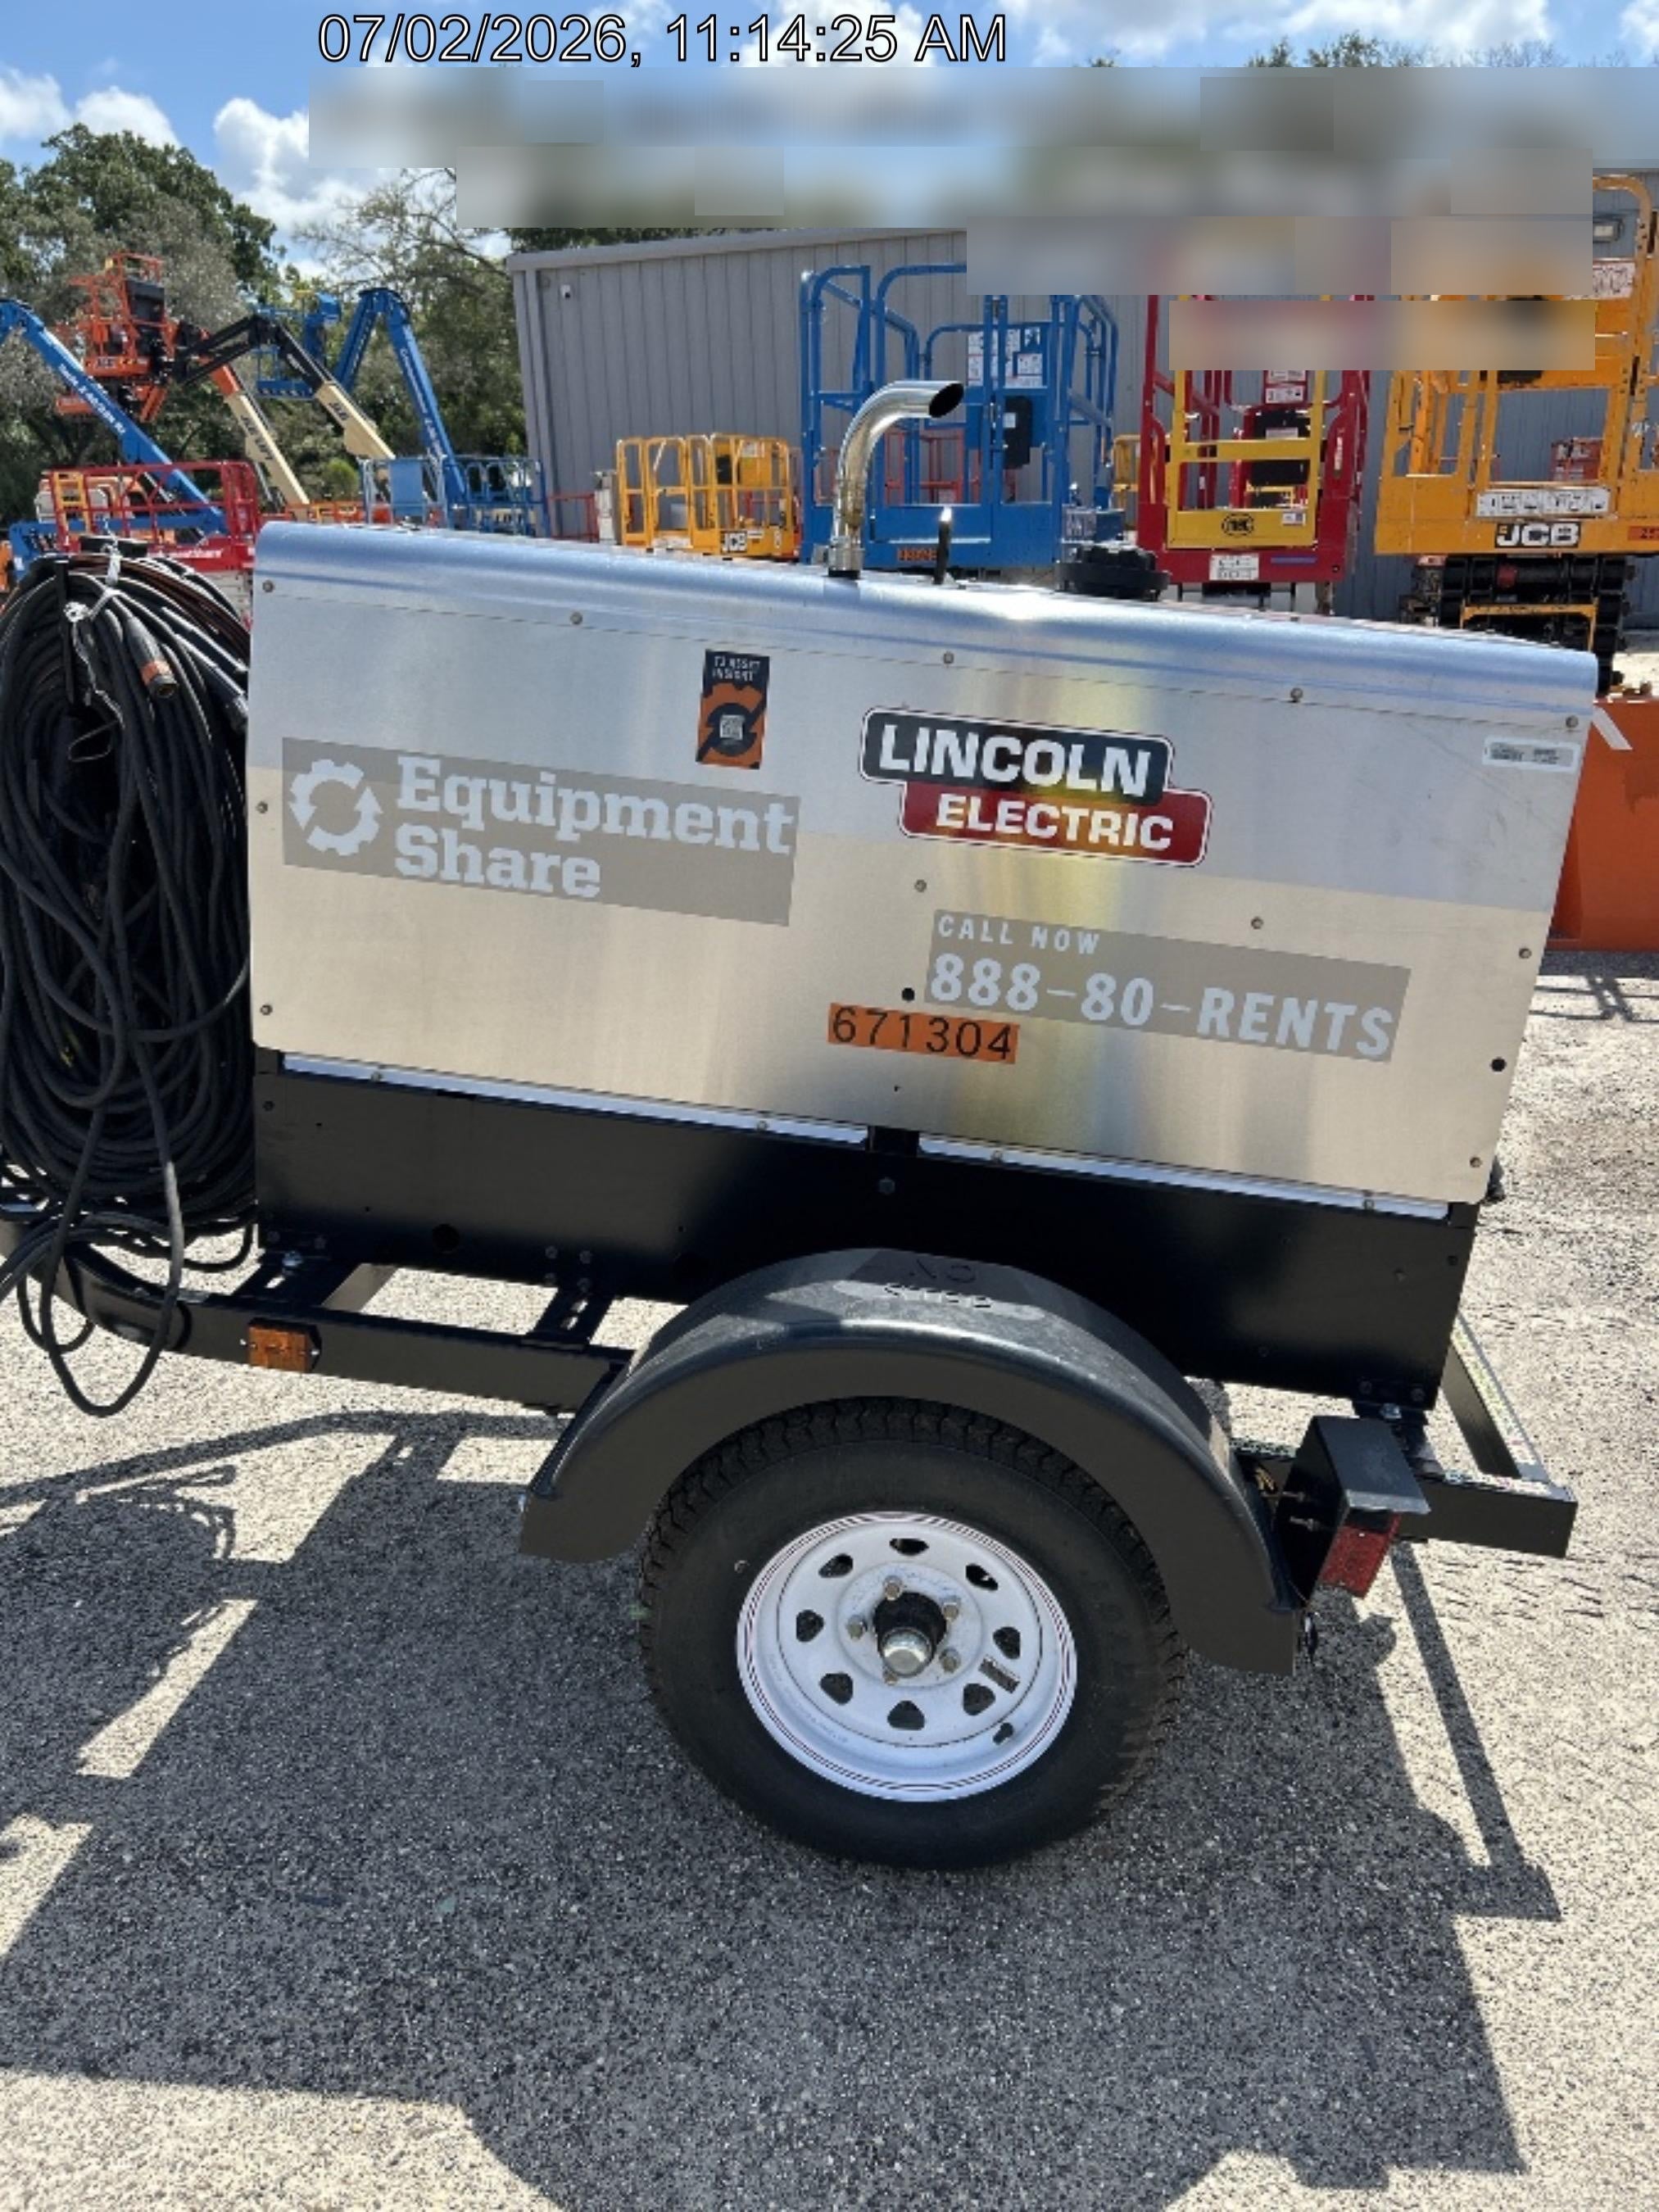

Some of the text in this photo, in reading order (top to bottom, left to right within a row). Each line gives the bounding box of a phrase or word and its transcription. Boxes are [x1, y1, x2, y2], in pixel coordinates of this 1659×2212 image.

[721, 532, 747, 552] JCB
[1496, 523, 1580, 548] JCB
[879, 723, 1152, 797] LINCOLN
[397, 755, 794, 855] Equipment
[936, 792, 1175, 851] ELECTRIC
[395, 823, 601, 899] Share
[937, 913, 1100, 956] CALL NOW
[831, 1005, 1015, 1060] 671304
[930, 951, 1395, 1058] 888-80-RENTS
